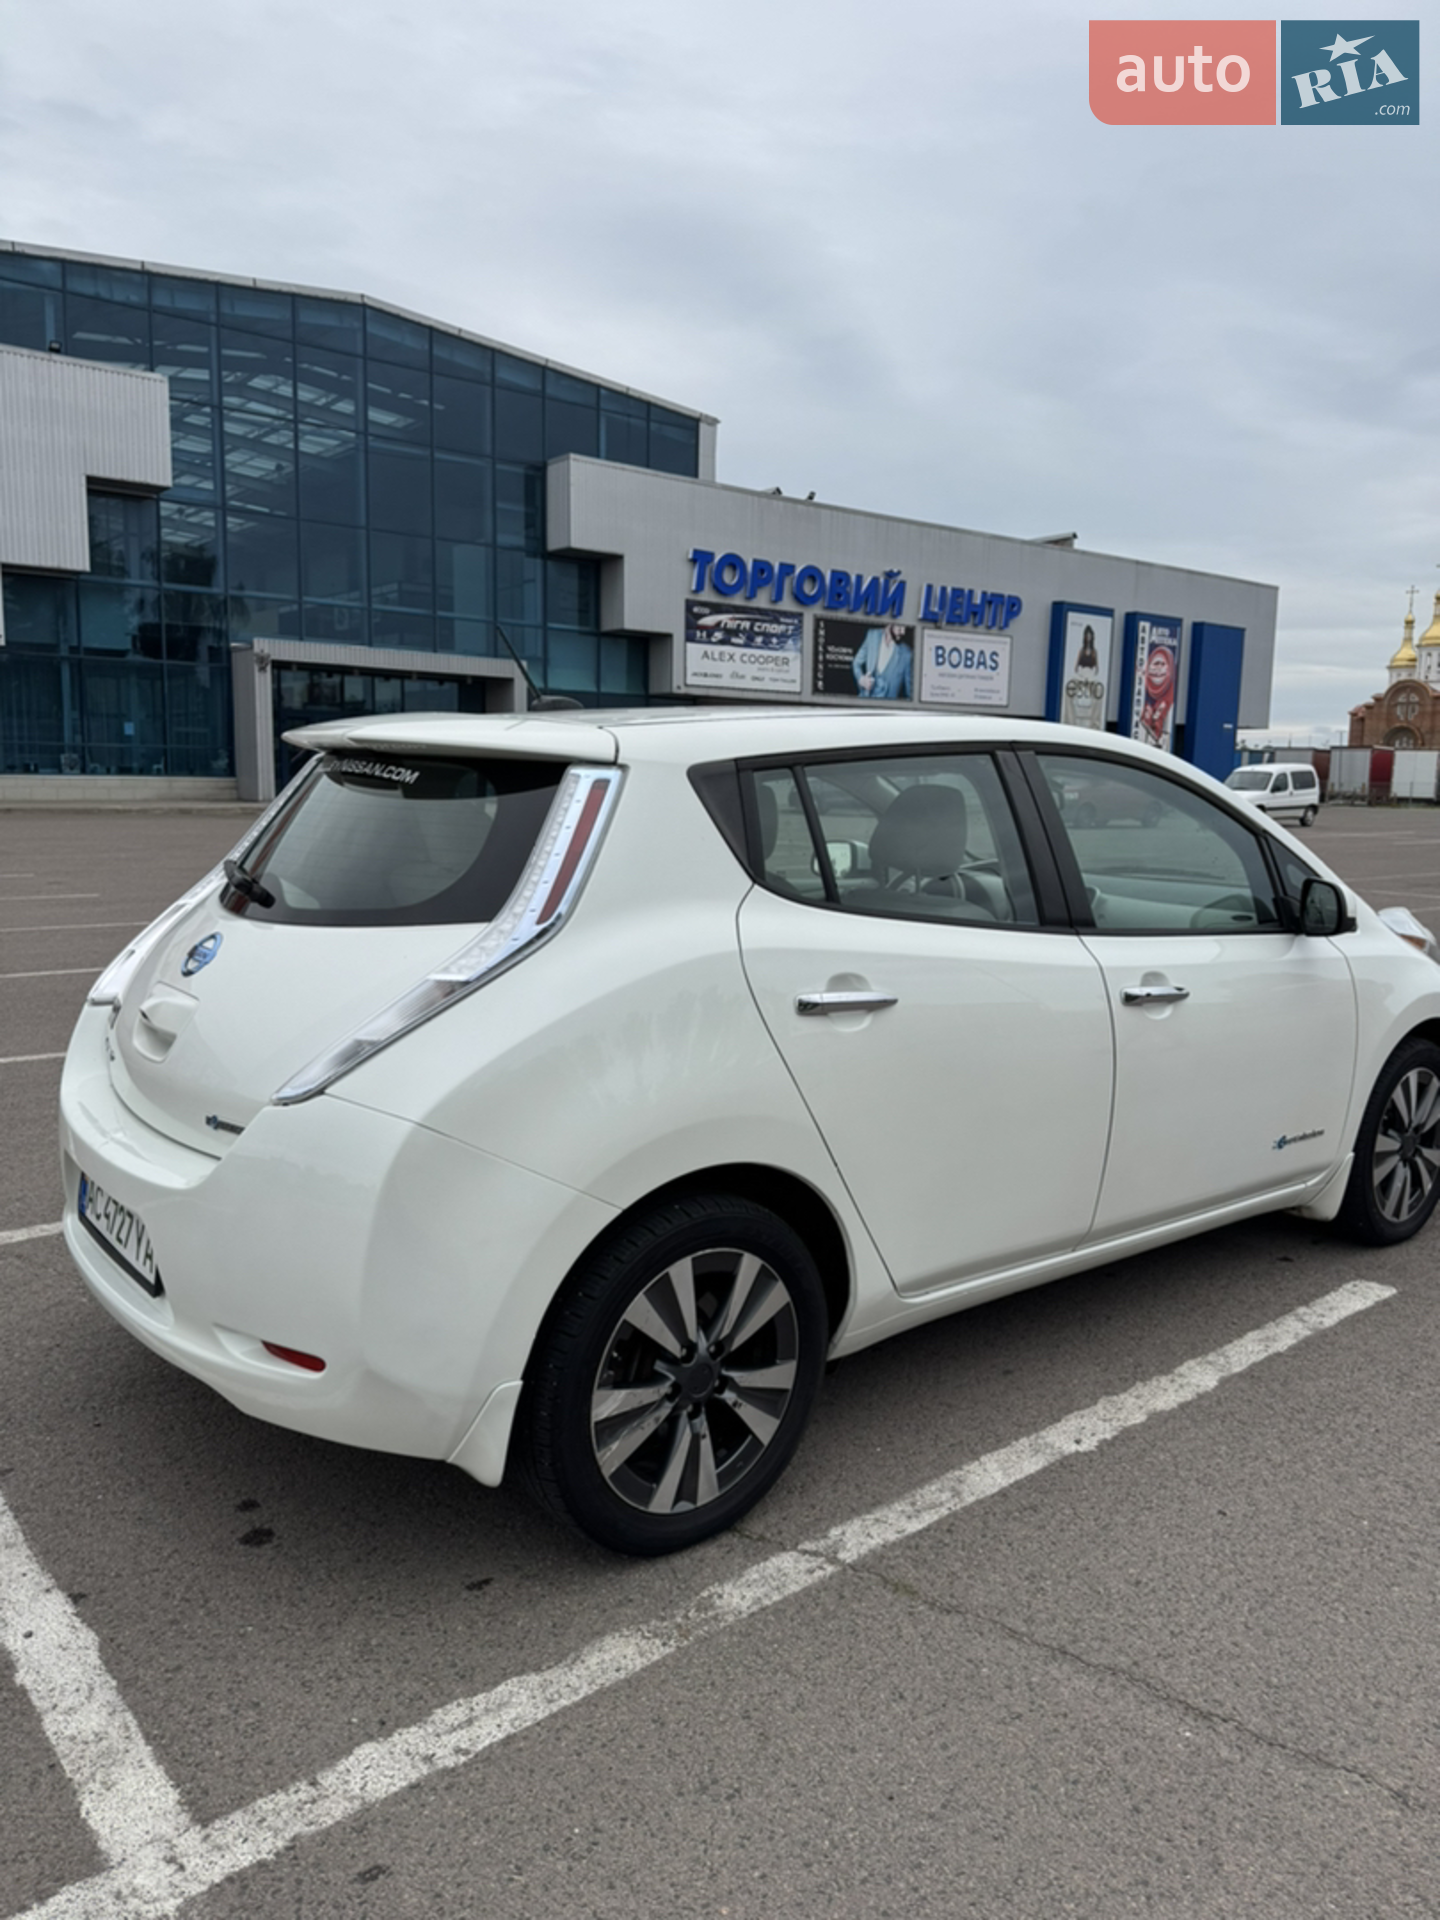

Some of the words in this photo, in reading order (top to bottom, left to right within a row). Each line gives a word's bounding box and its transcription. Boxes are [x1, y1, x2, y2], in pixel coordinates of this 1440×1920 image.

[689, 549, 907, 618] ТОРГОВИЙ
[919, 583, 1023, 630] ЦЕНТР
[701, 650, 736, 663] ALEX
[740, 653, 790, 667] COOPER
[935, 645, 1000, 672] BOBAS
